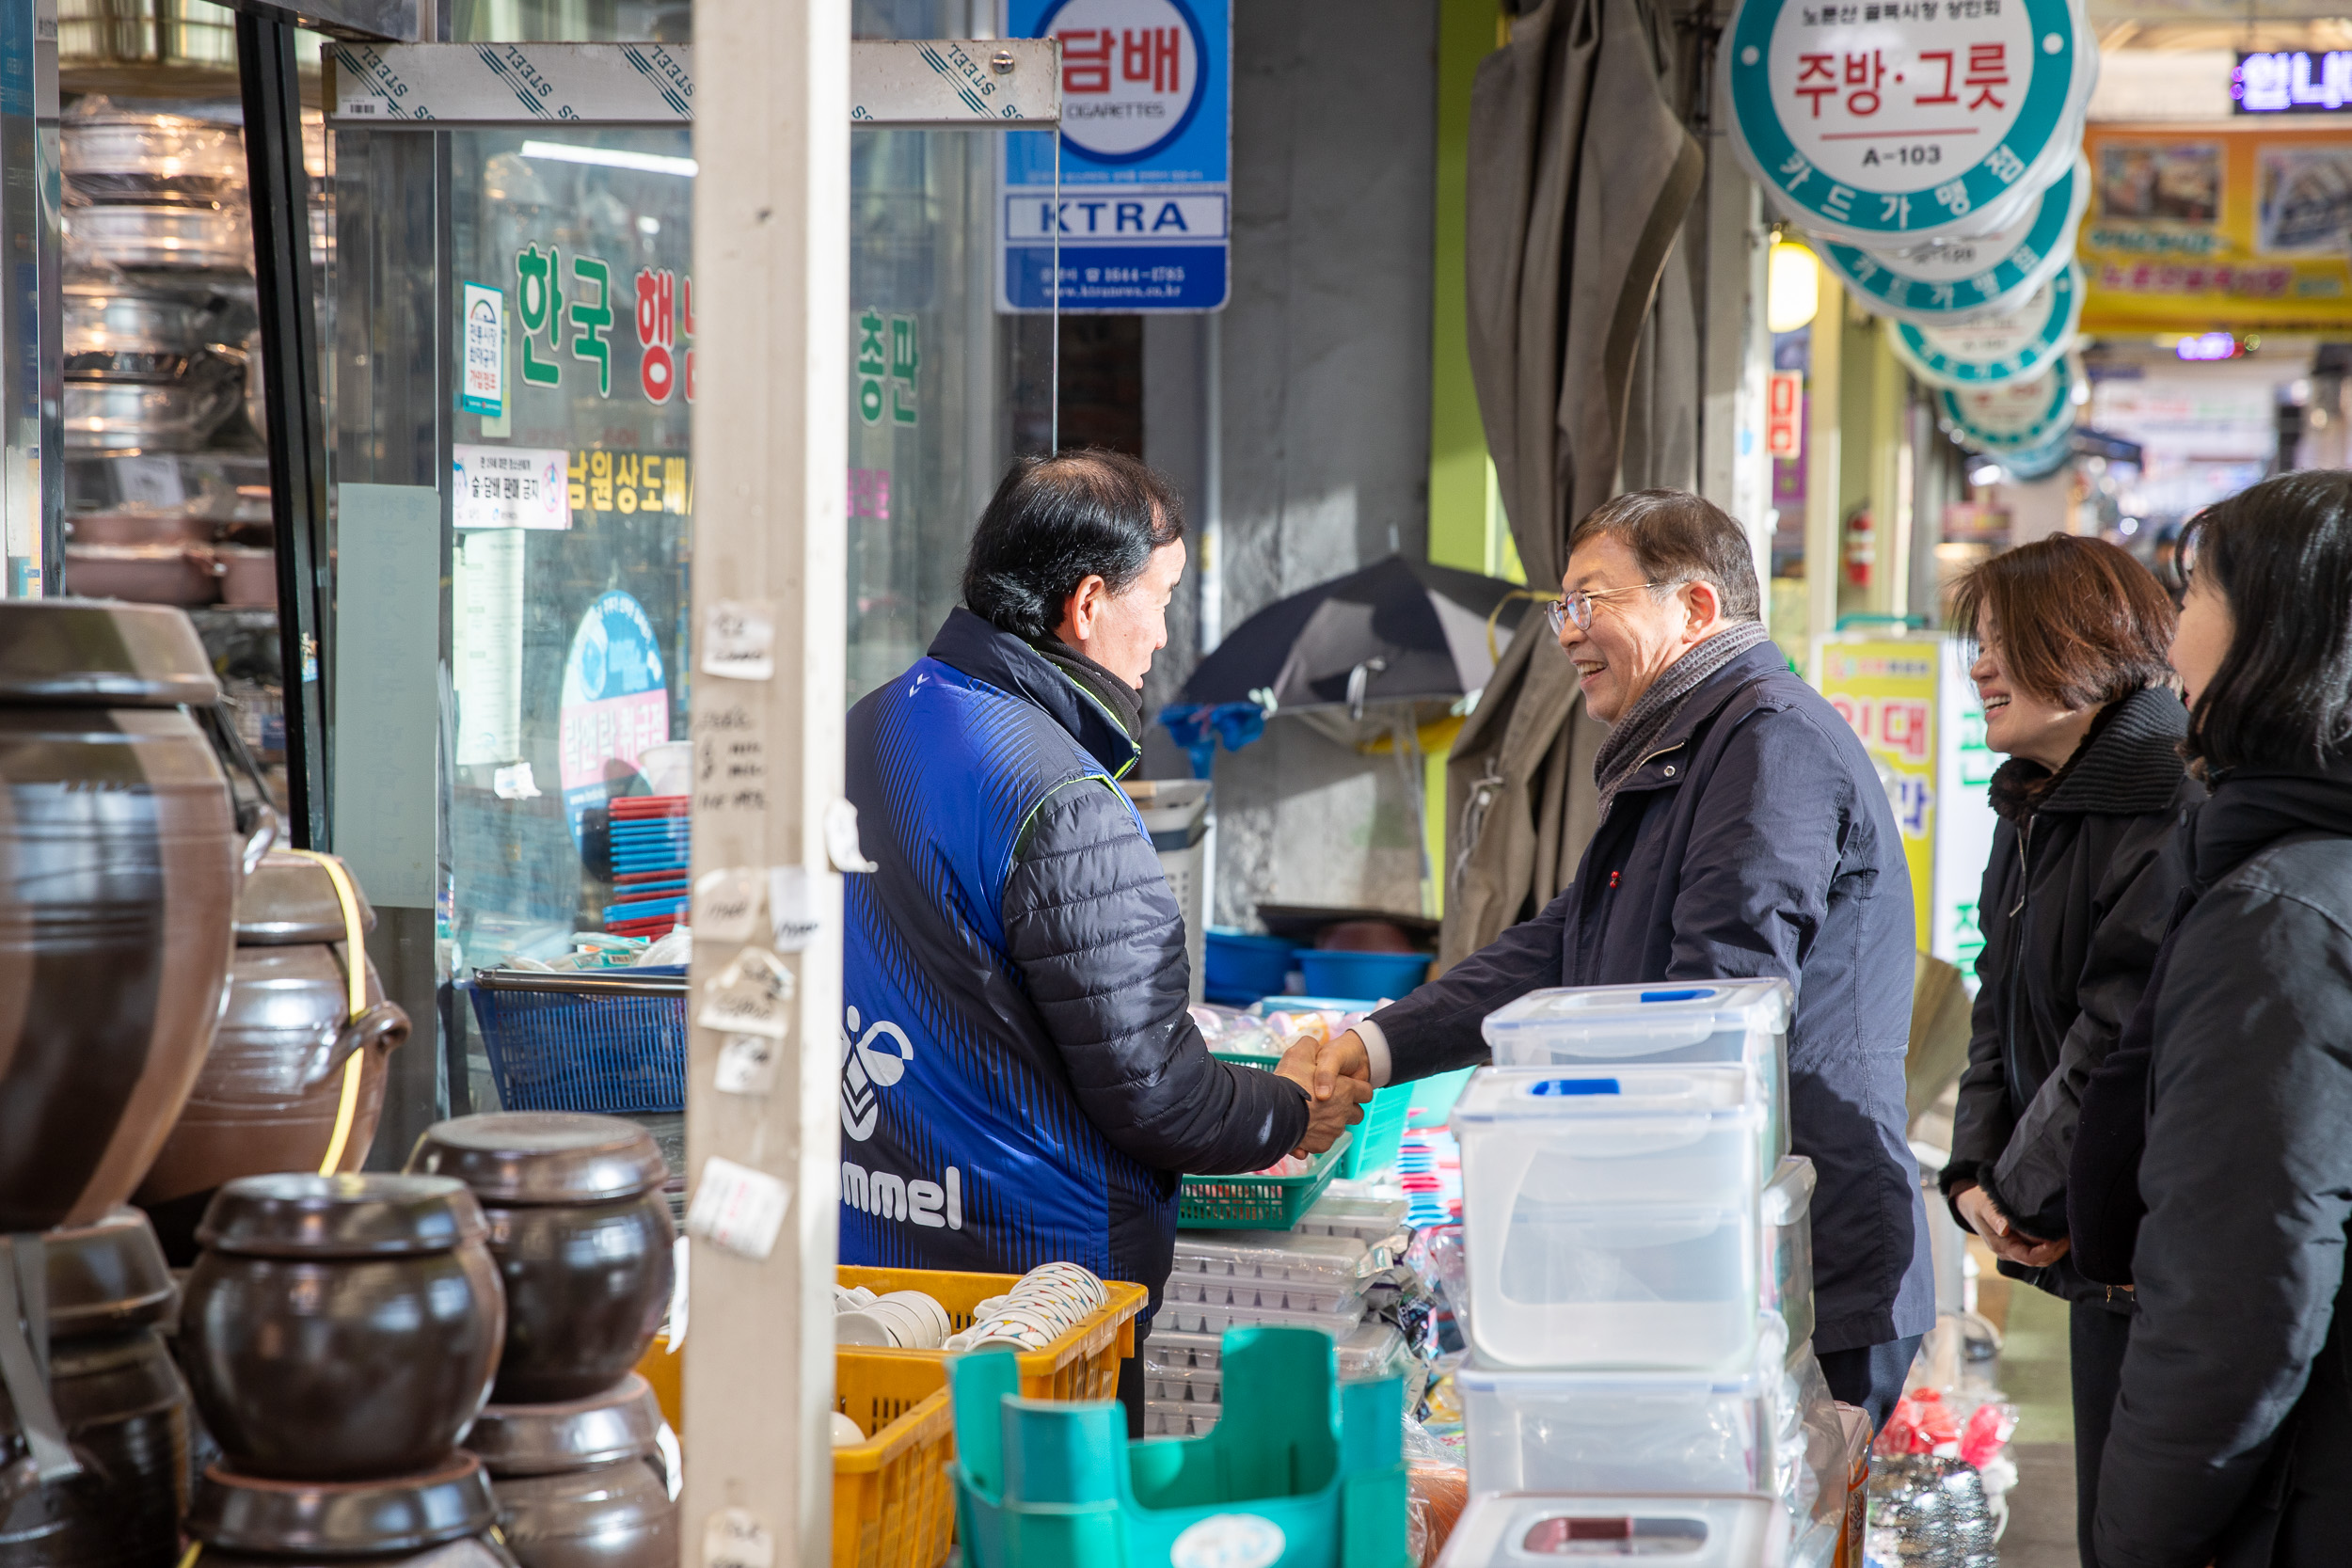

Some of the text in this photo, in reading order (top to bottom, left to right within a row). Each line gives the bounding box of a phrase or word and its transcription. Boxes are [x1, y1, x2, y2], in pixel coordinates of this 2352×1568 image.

[360, 45, 409, 98] STEEL
[503, 44, 554, 98] STEEL
[946, 43, 997, 96] STEEL
[1056, 25, 1181, 94] 담배
[1795, 41, 2010, 119] 주방·그릇
[1862, 144, 1942, 168] A-103
[1041, 201, 1189, 233] KTRA
[516, 241, 614, 400] 한국
[855, 305, 921, 428] 총판
[503, 477, 520, 499] 판매
[523, 479, 540, 500] 금지
[835, 1160, 962, 1230] mmel
